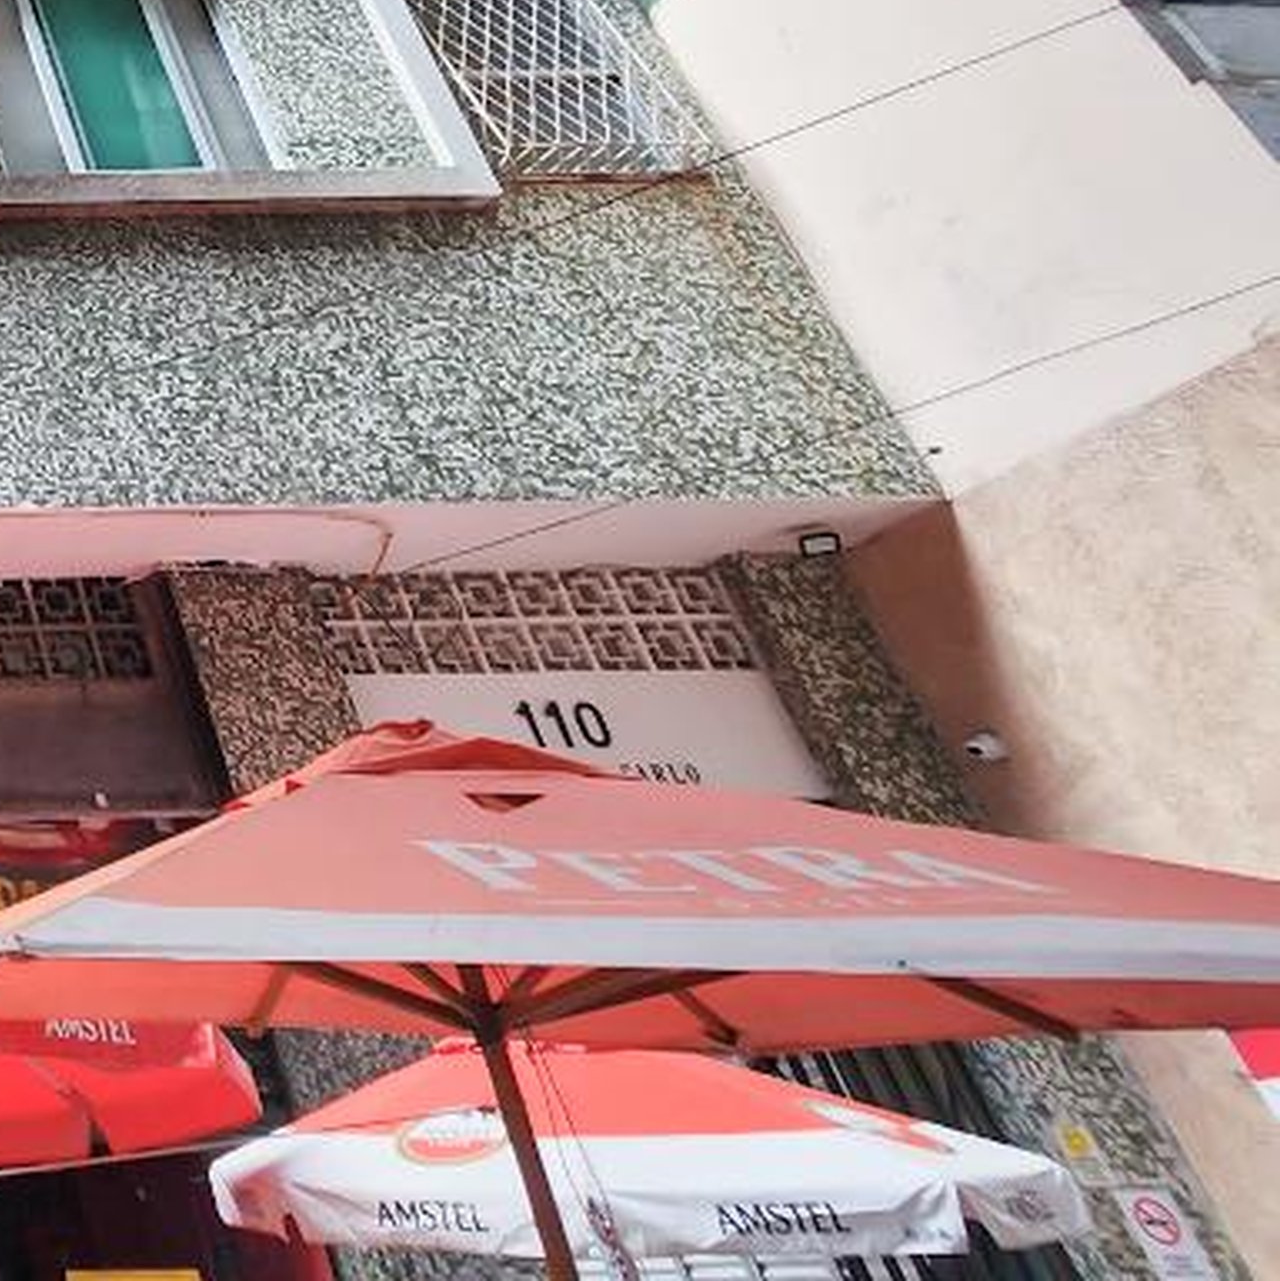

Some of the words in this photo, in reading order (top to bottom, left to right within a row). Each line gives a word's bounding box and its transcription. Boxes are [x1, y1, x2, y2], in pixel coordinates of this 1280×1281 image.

[514, 700, 612, 749] 110
[404, 838, 1068, 893] PETRA
[44, 1016, 138, 1046] AMSTEL
[376, 1198, 491, 1234] AMSTEL
[714, 1200, 854, 1237] AMSTEL
